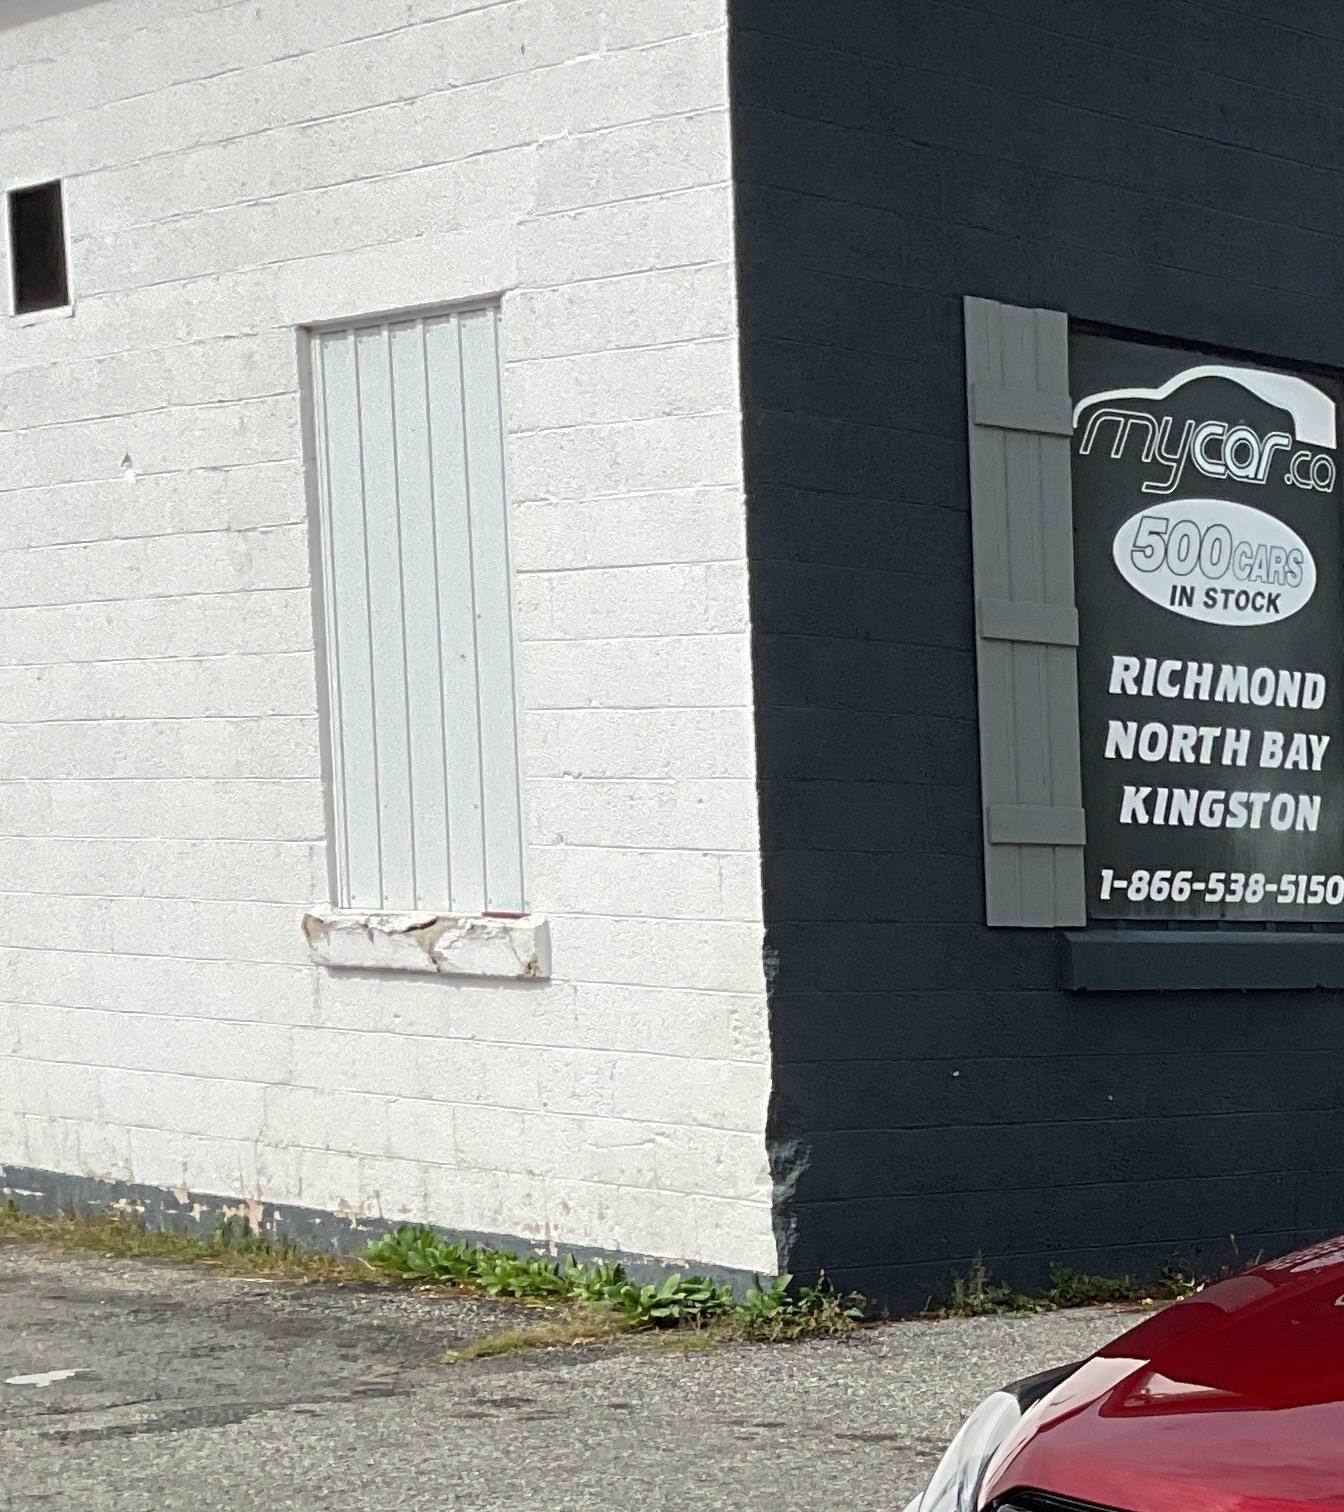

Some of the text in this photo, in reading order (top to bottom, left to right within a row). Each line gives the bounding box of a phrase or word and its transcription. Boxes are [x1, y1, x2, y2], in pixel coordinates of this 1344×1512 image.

[1169, 584, 1282, 614] IN STOCK
[1108, 655, 1326, 710] RICHMOND
[1104, 720, 1331, 771] NORTH BAY
[1119, 785, 1321, 832] KINGSTON
